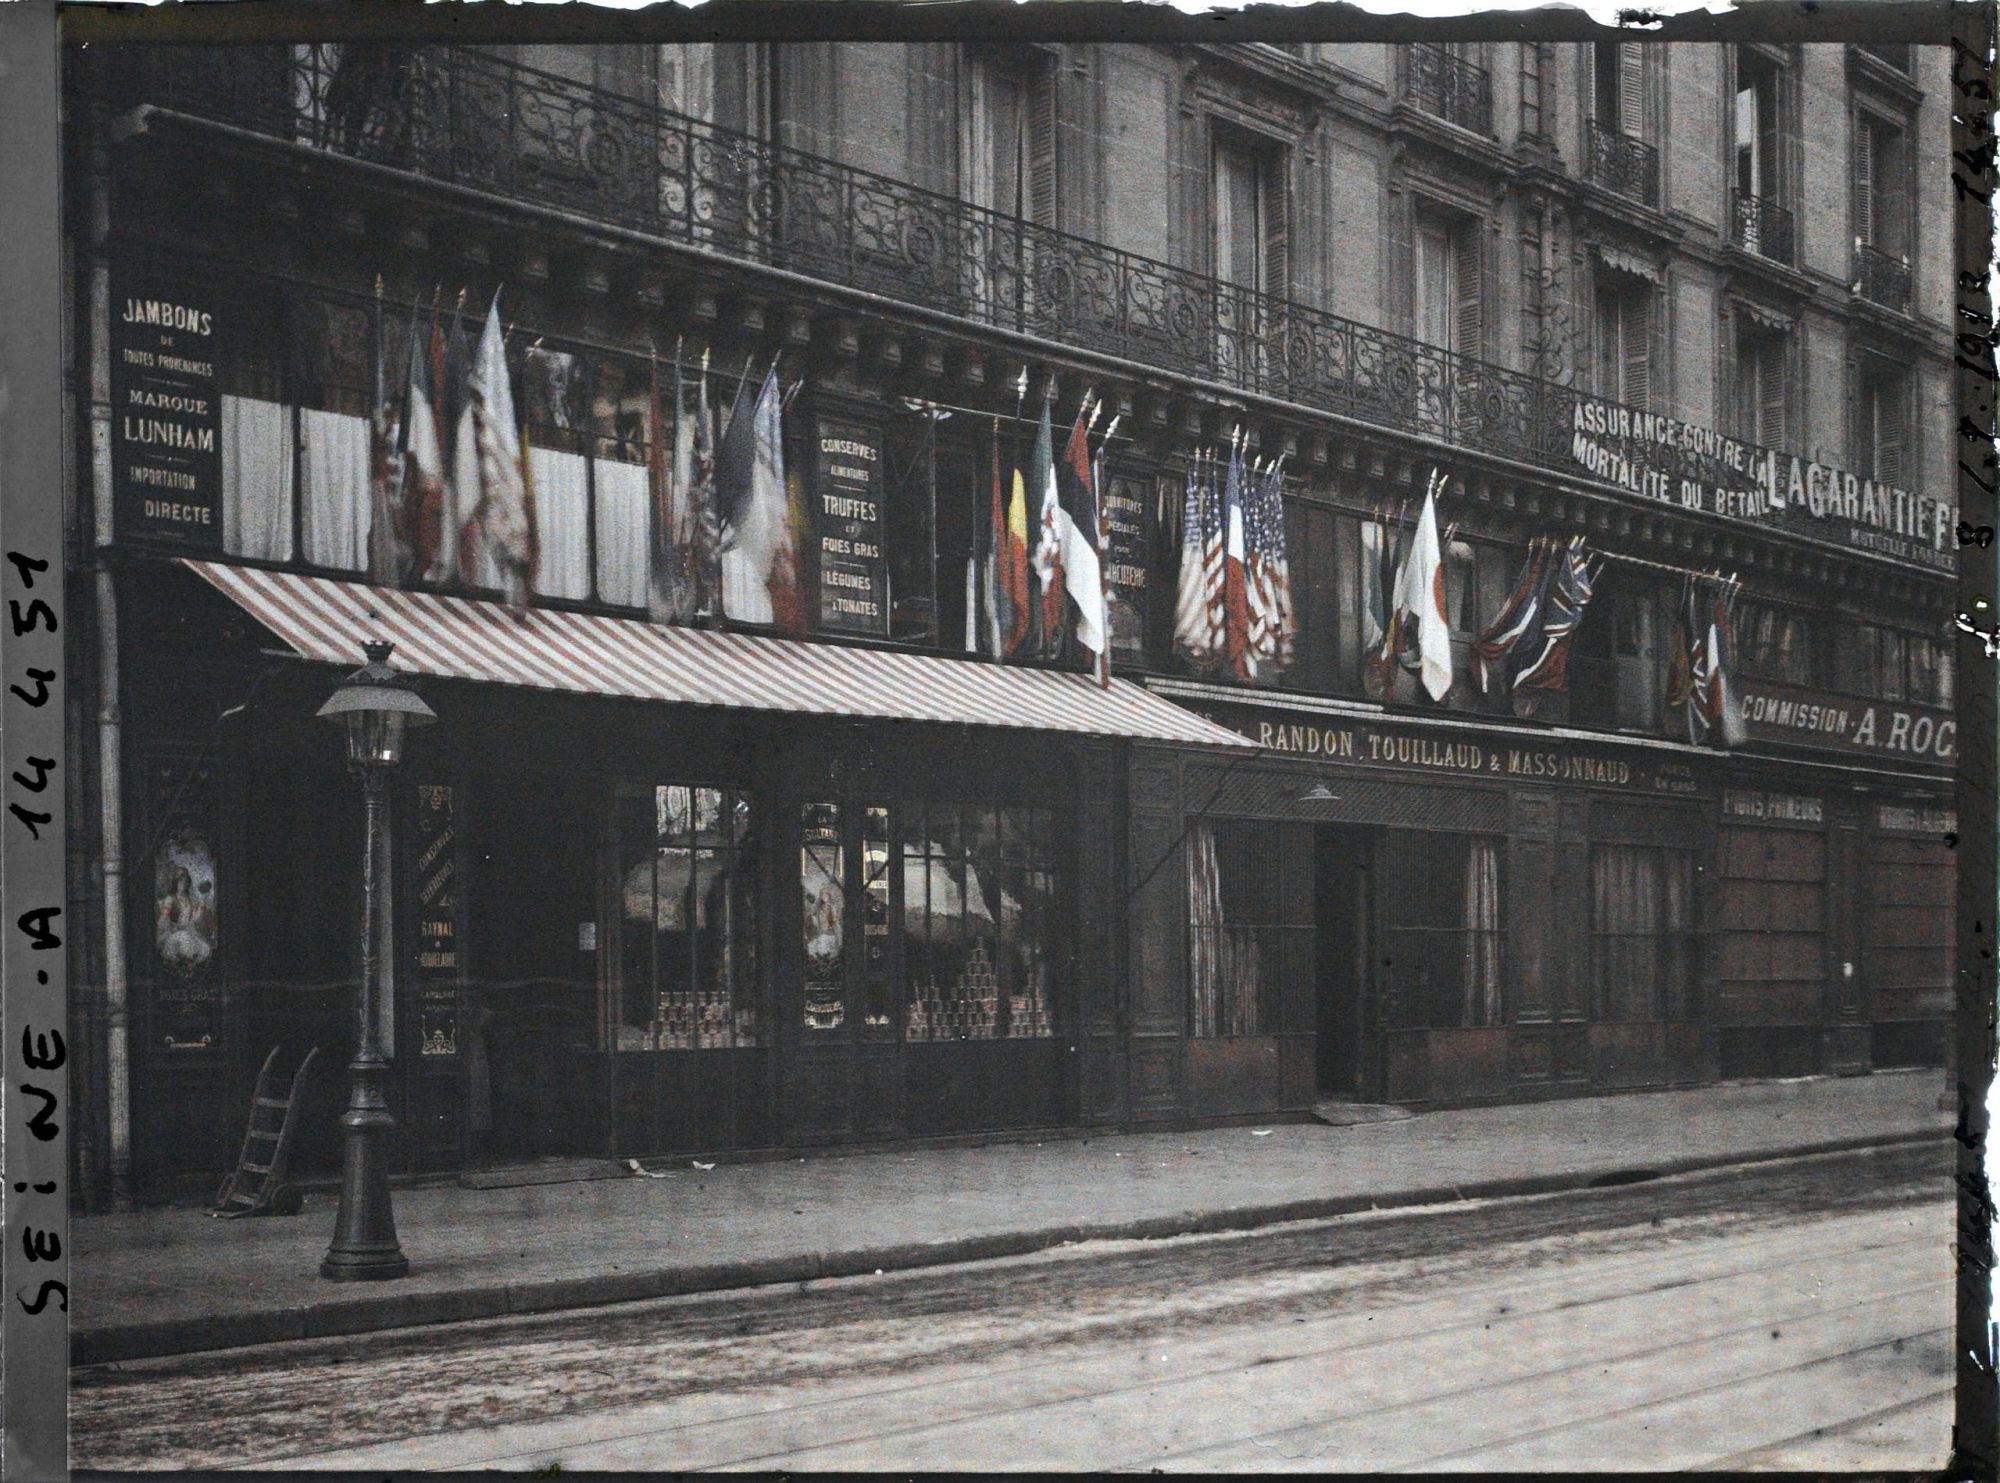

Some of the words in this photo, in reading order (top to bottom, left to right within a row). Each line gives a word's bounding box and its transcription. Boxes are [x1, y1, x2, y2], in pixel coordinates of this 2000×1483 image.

[122, 298, 212, 336] JAMBONS
[160, 336, 173, 347] DE
[124, 348, 155, 367] TOUTES
[157, 354, 213, 378] PROVENANCES
[129, 389, 208, 415] MARQUE
[123, 416, 214, 453] LUNHAM
[1574, 402, 1677, 447] ASSURANCE
[1682, 423, 1743, 472] CONTRE
[821, 438, 878, 462] CONSERVES
[130, 465, 196, 491] IMPORTATION
[822, 494, 878, 522] TRUFFES
[1681, 478, 1702, 510] DU
[1767, 450, 1807, 509] LA
[1807, 462, 1933, 540] GARANTIE
[145, 499, 211, 525] DIRECTE
[822, 536, 850, 555] FOIES
[853, 542, 879, 559] GRAS
[1740, 694, 1849, 735] COMMISSION
[1369, 733, 1482, 771] TOUILLAUD
[1490, 753, 1502, 772] &
